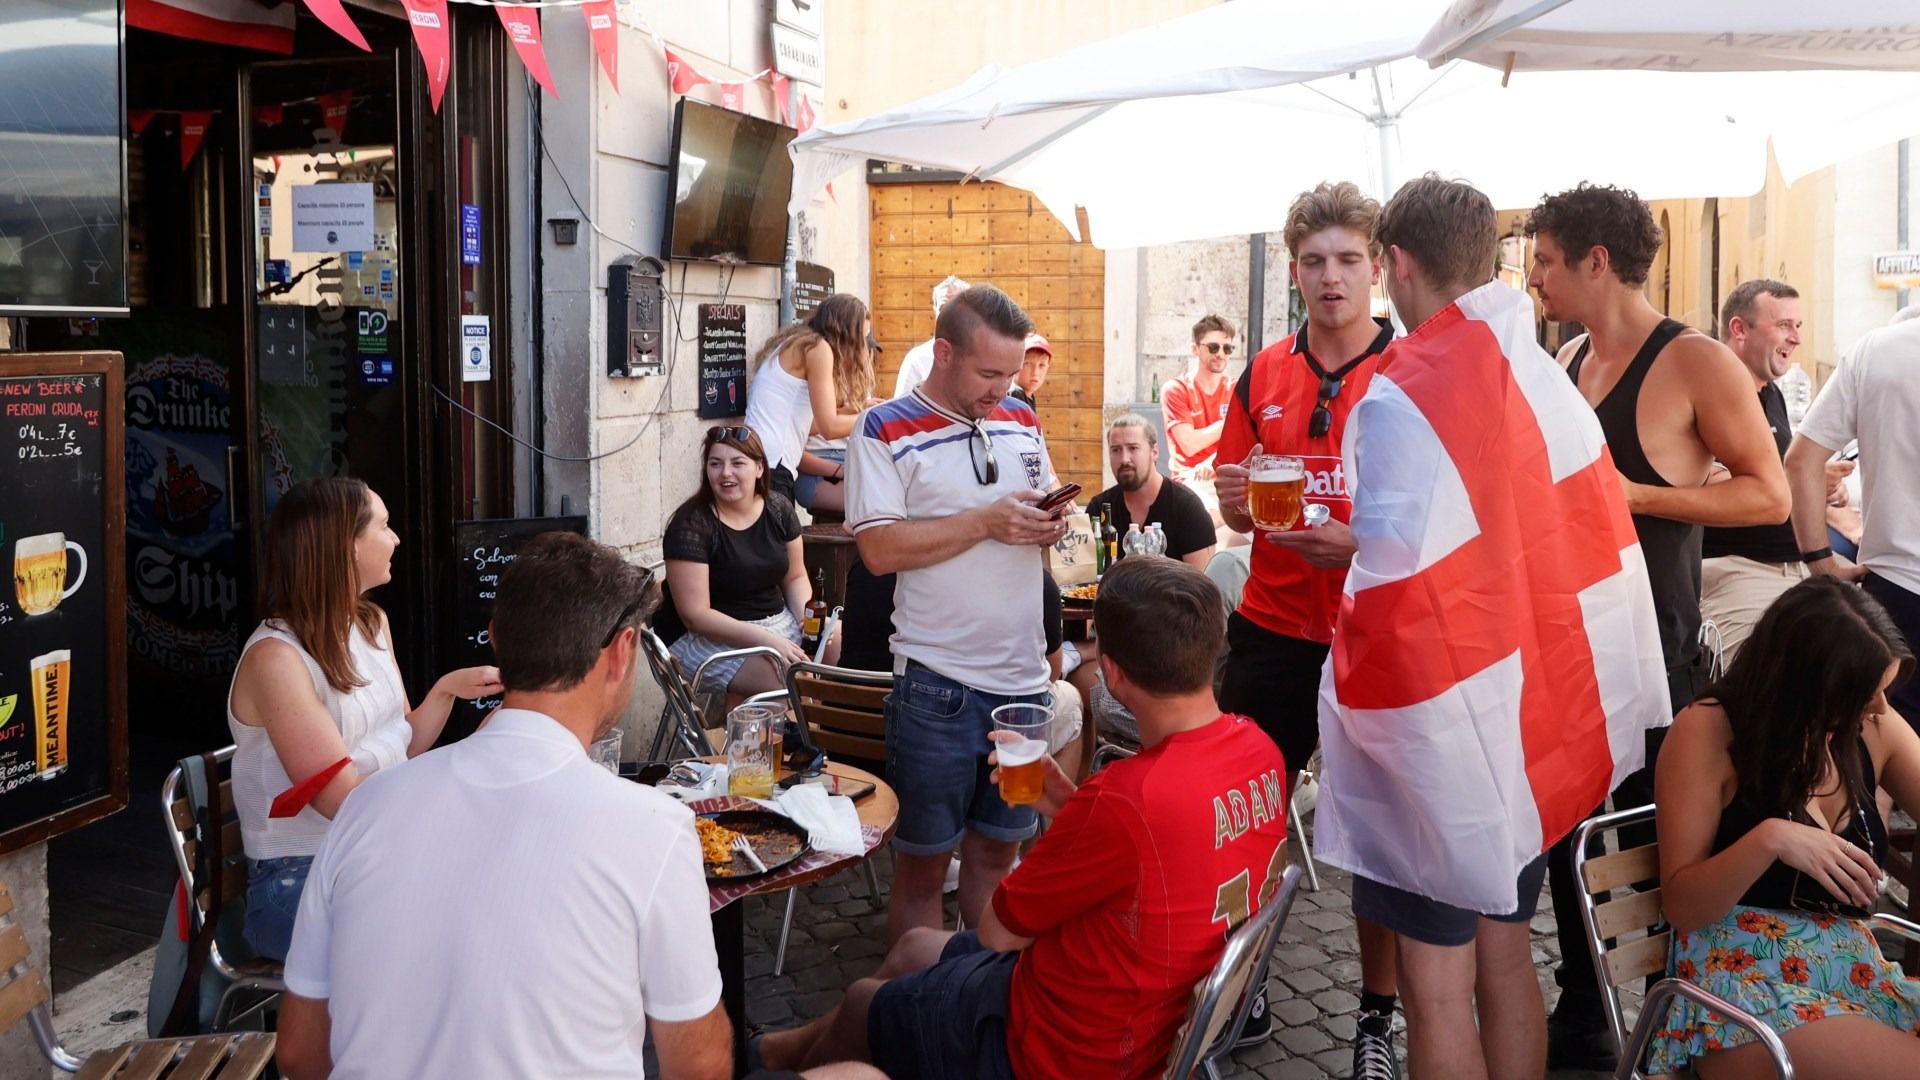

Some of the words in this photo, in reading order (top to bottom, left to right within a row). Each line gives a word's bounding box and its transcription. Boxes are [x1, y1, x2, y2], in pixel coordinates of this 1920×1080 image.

[779, 42, 819, 69] CARABINIERI
[465, 327, 486, 335] NOTICE
[5, 384, 31, 396] NEW
[167, 377, 199, 403] The
[7, 403, 46, 417] PERONI
[52, 402, 83, 416] CRUDA
[135, 544, 239, 626] Ship
[1213, 770, 1284, 850] ADAM
